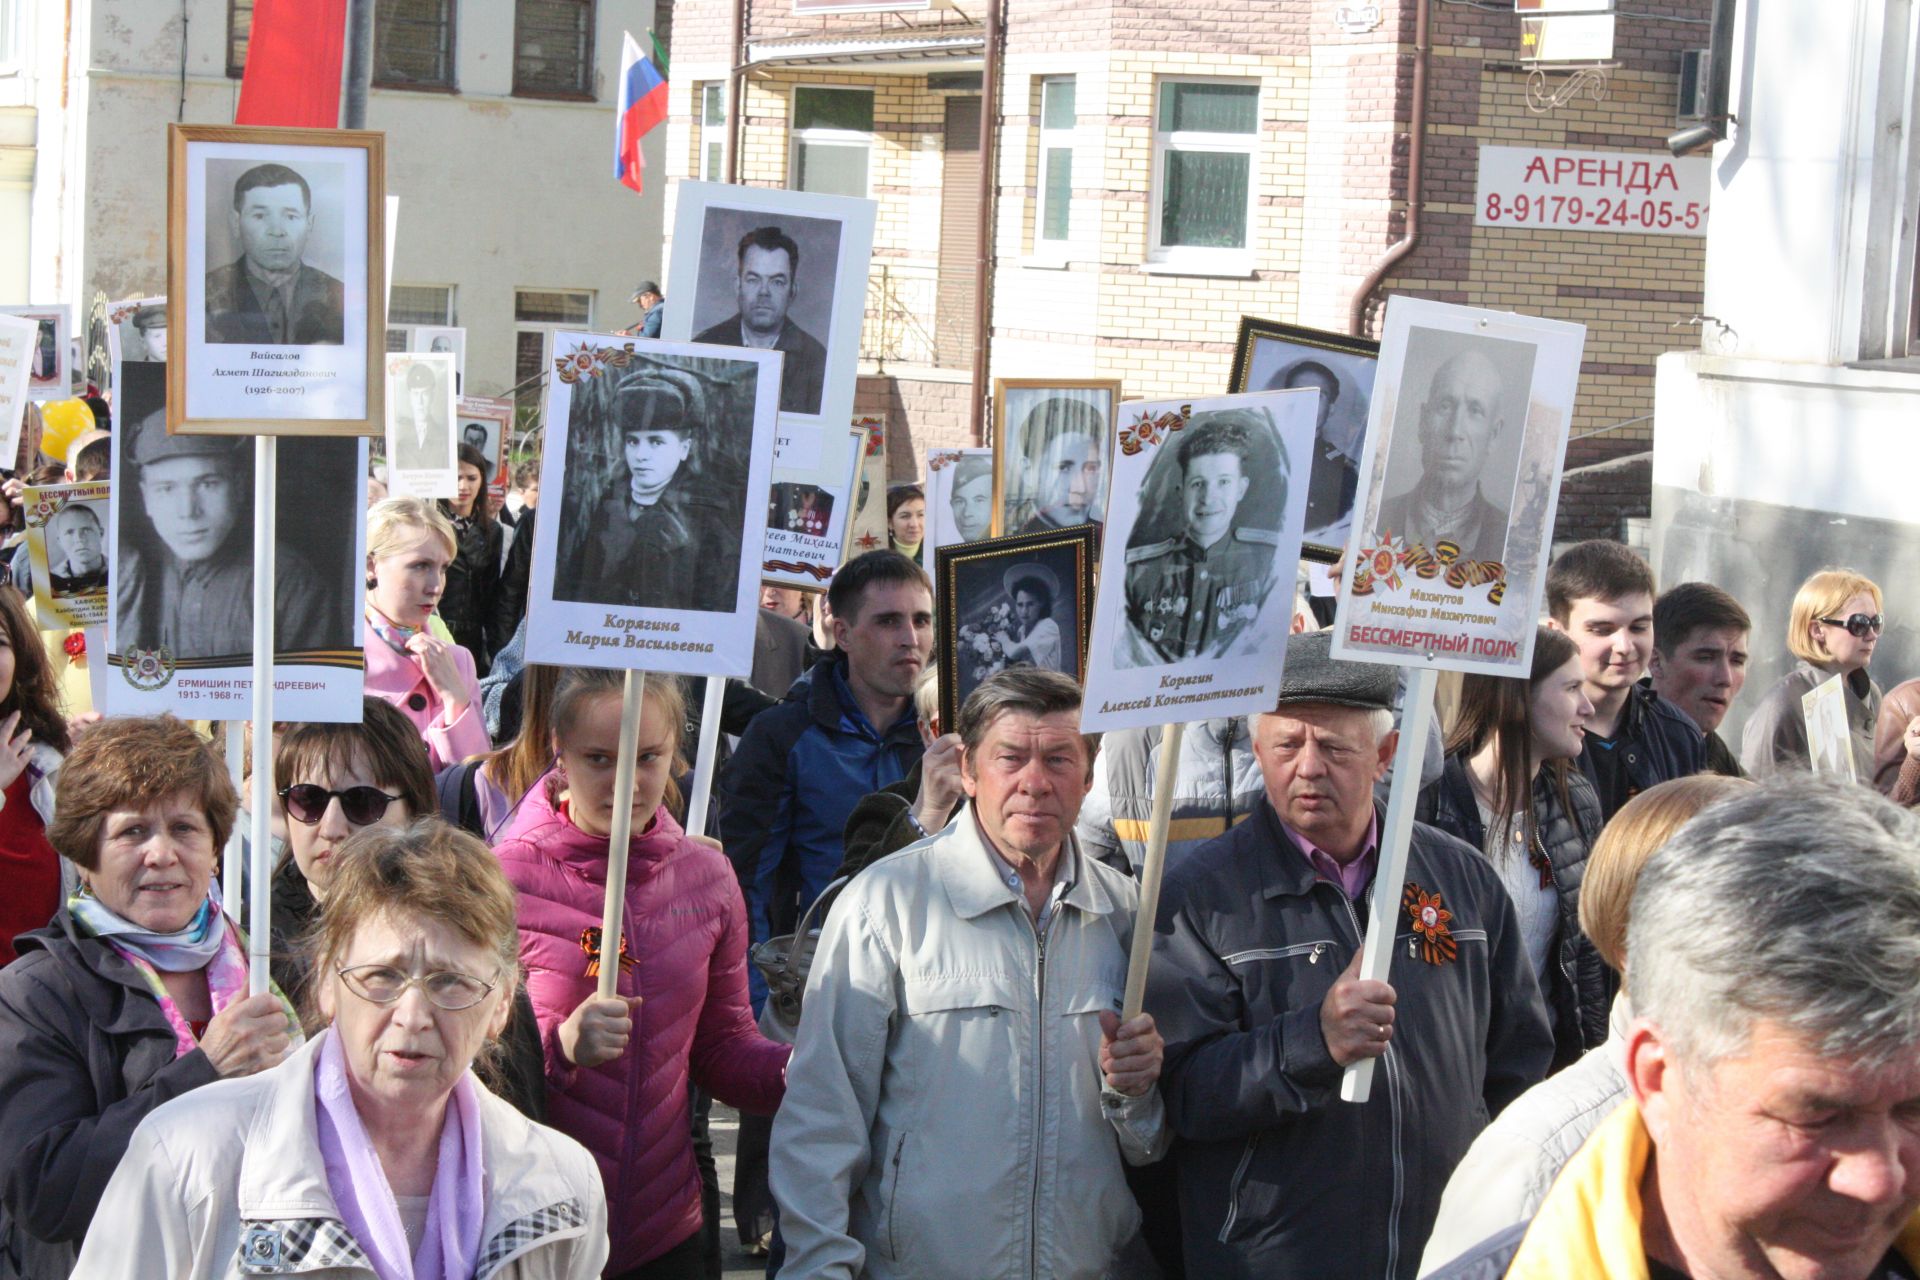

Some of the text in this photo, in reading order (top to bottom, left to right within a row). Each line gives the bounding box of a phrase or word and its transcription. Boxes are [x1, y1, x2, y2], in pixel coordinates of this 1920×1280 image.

[1524, 156, 1679, 195] АРЕНДА
[250, 350, 300, 360] Вайсалов
[212, 367, 249, 377] Ахмет
[244, 385, 305, 396] (1926-2007)
[96, 486, 111, 496] ПОЛ
[765, 530, 839, 550] еев Михаил
[1410, 588, 1464, 605] Махмутов
[1371, 601, 1497, 625] Минхафиз Махмутович
[603, 613, 680, 633] Корягина
[564, 630, 715, 653] Мария Васильевна
[1349, 625, 1518, 658] БЕССМЕРТНЫЙ ПОЛК
[177, 679, 326, 691] ЕРМИШИН ПЕТ НДРЕЕВИЧ
[1159, 672, 1213, 690] Корягин
[177, 690, 200, 699] 1913
[209, 691, 231, 700] 1968
[1098, 685, 1264, 714] Алексей Константинович
